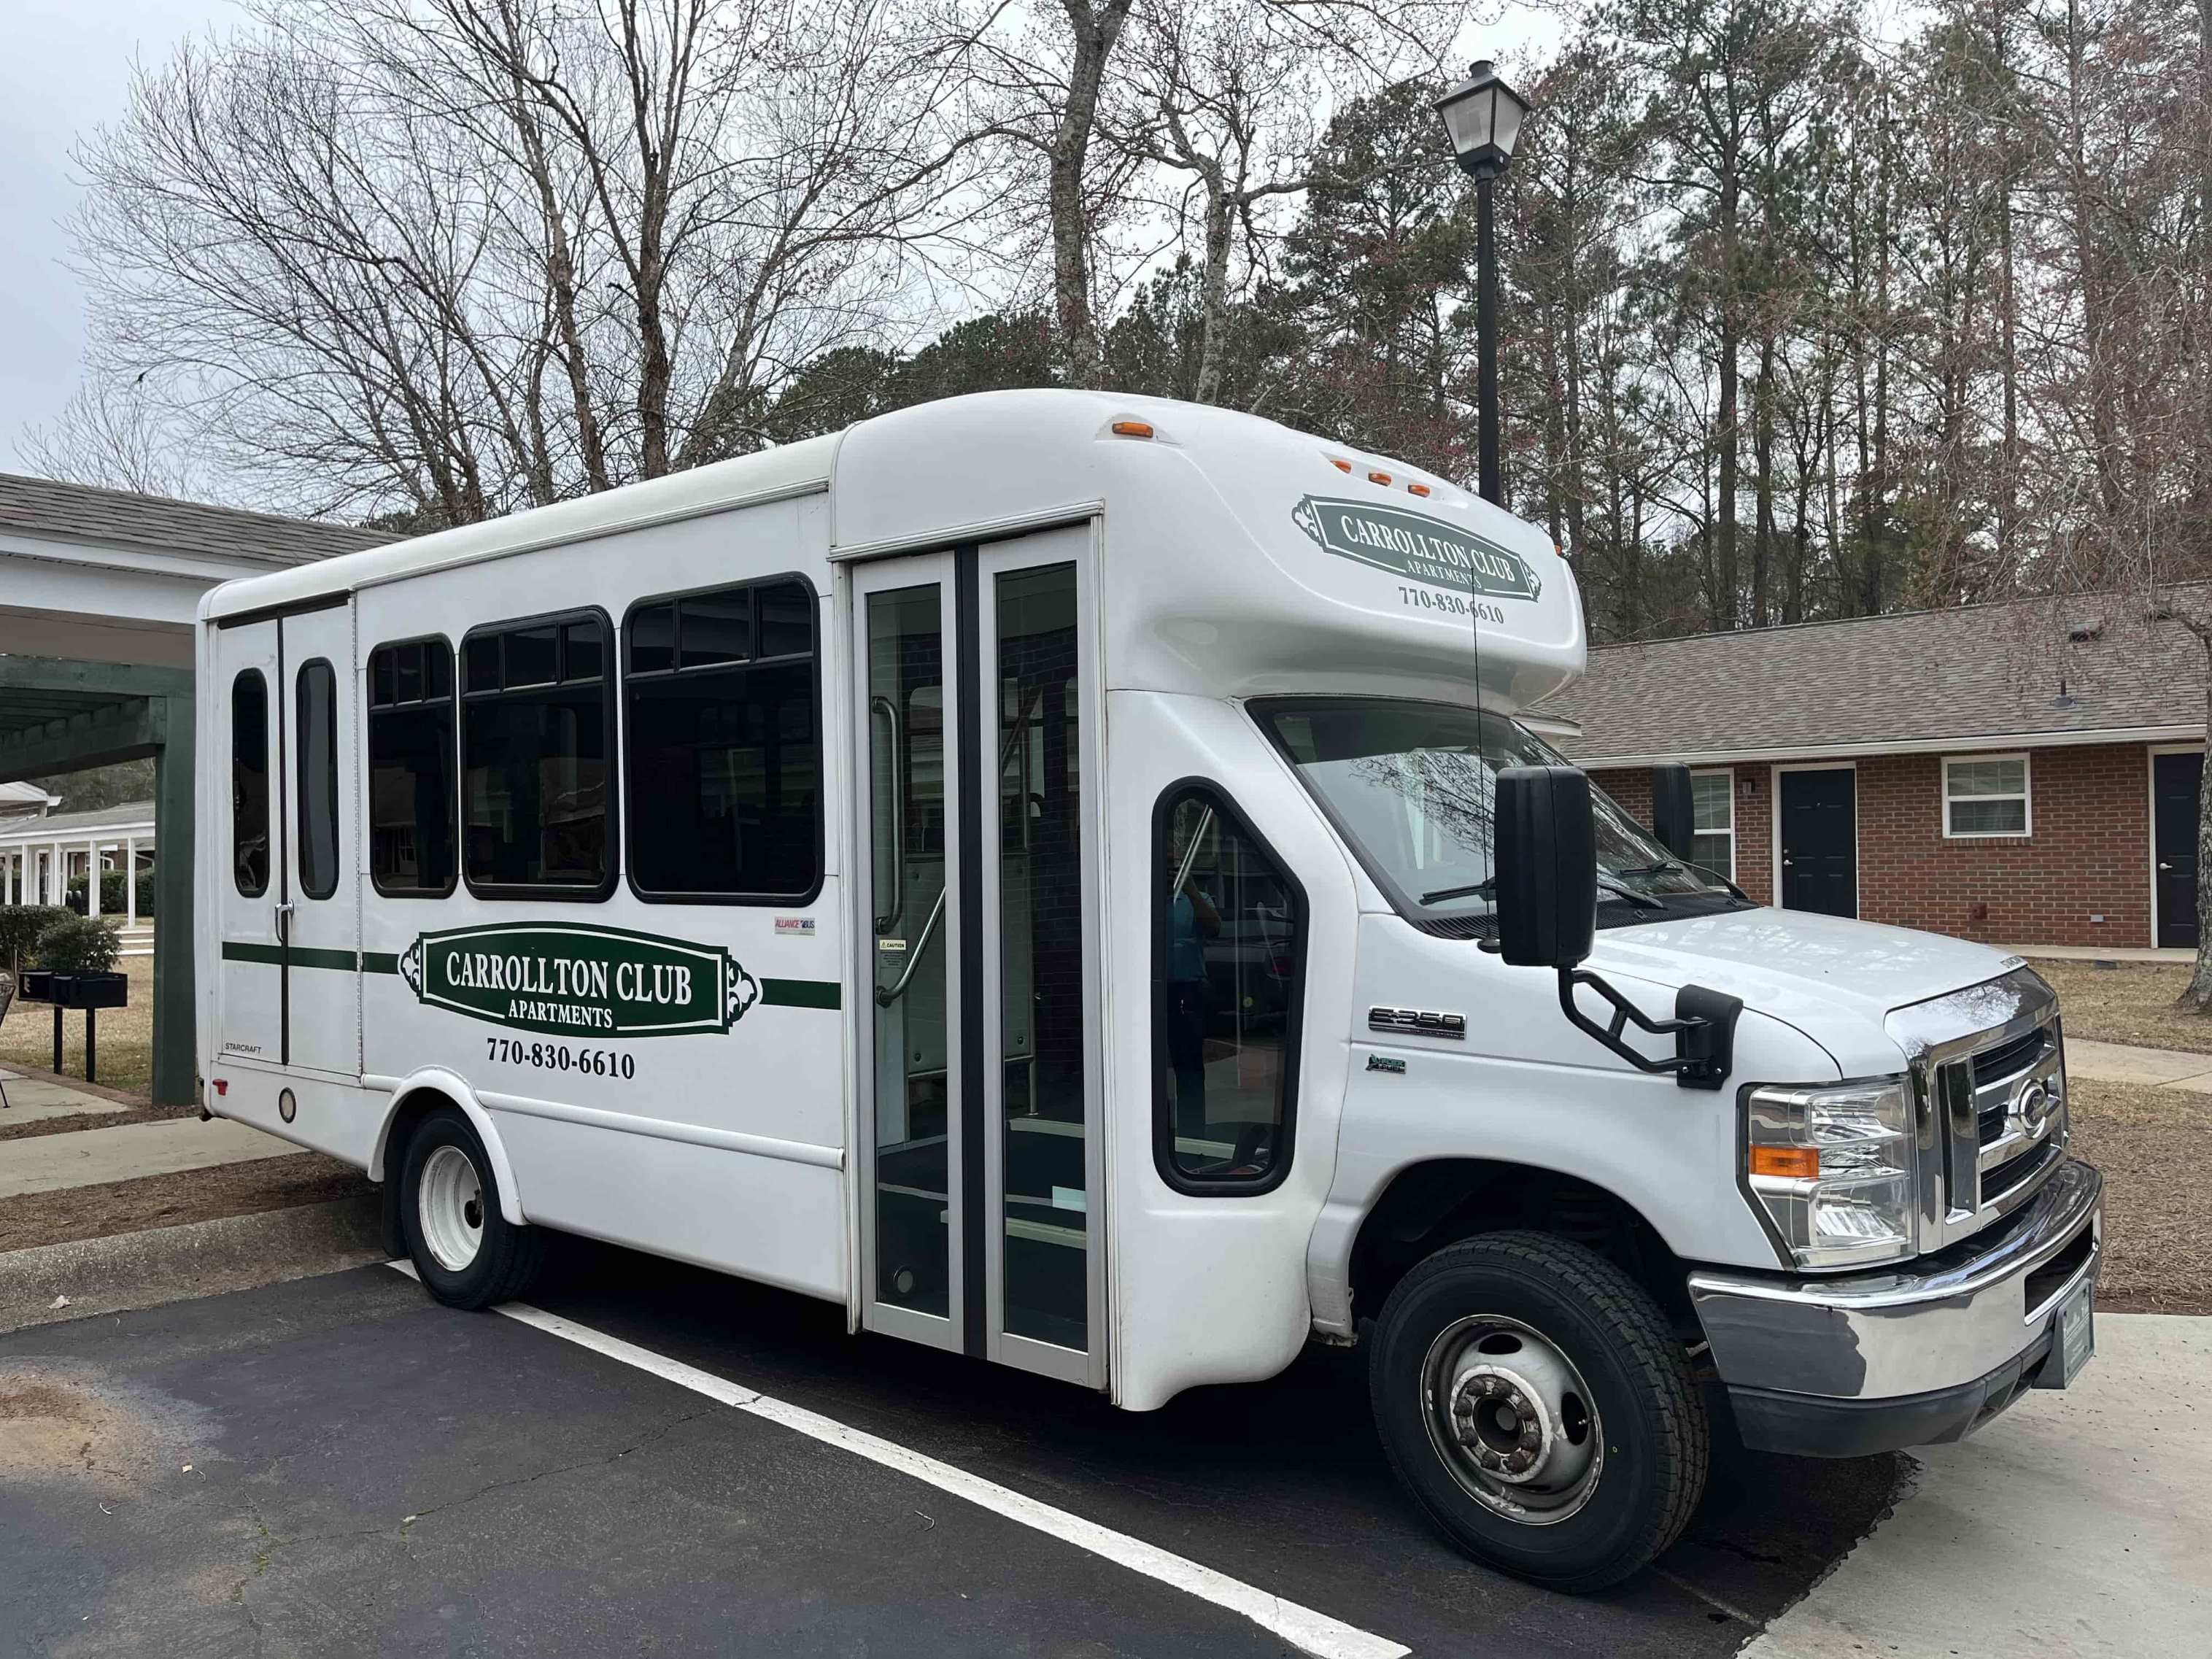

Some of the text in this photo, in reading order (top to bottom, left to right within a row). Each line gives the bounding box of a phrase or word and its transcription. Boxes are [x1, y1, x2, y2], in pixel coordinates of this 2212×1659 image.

[1341, 515, 1515, 582] CARROLLTON CLUB
[1407, 560, 1482, 589] APARTMENTS
[1399, 587, 1504, 624] 770-830-6610
[446, 951, 692, 1005] CARROLLTON CLUB
[508, 999, 613, 1029] APARTMENTS
[225, 1043, 262, 1053] STARCRAFT
[487, 1038, 635, 1080] 770-830-6610
